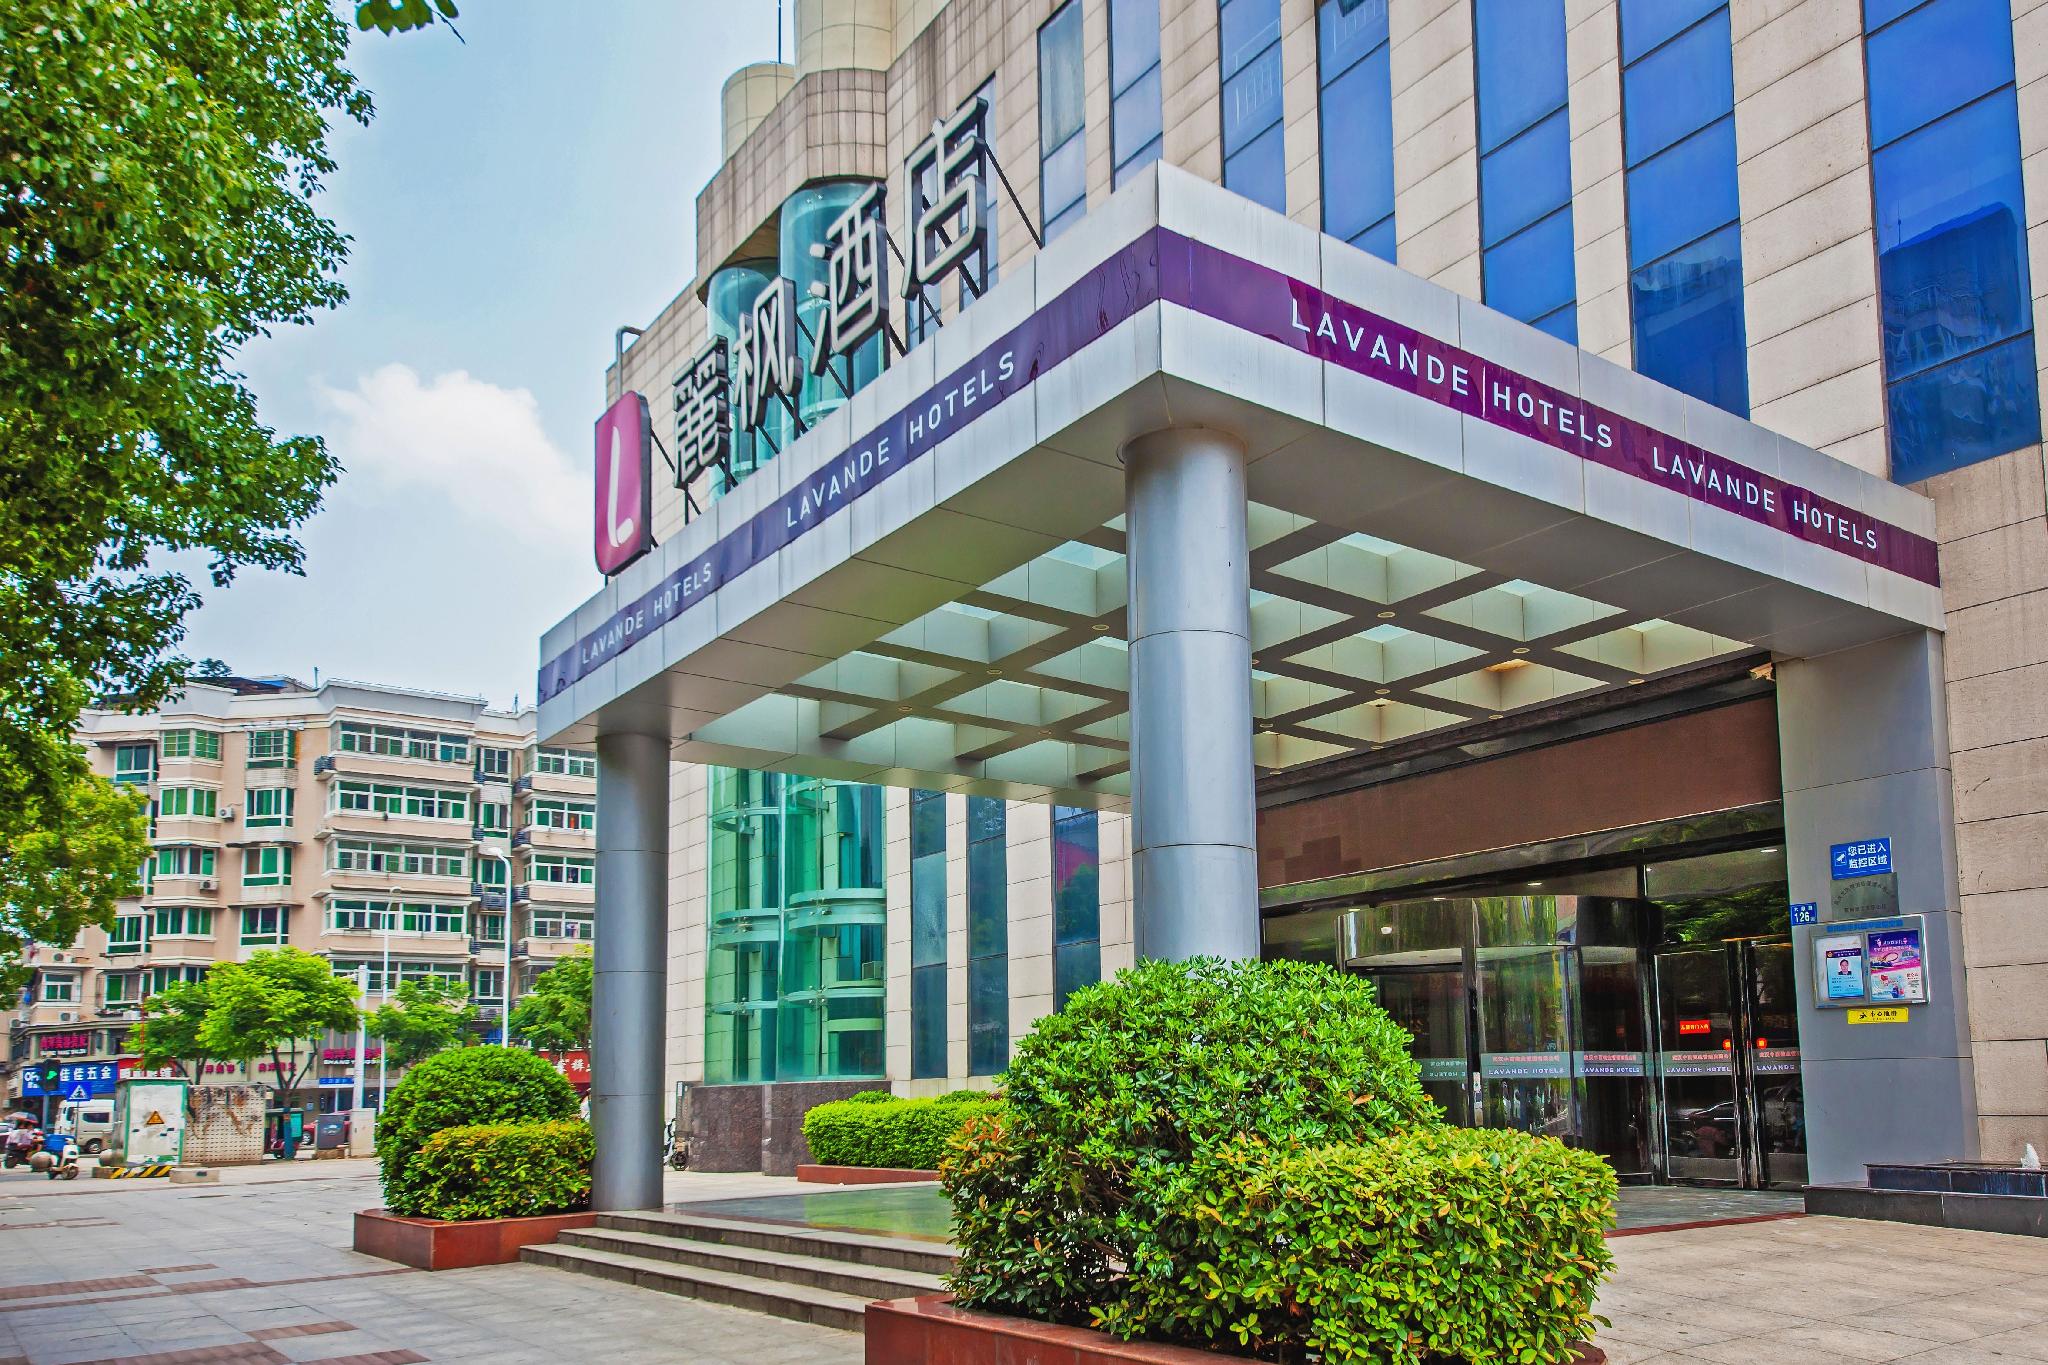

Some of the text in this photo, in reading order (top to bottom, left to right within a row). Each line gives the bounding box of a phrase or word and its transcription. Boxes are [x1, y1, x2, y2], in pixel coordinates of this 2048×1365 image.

[1291, 298, 1613, 448] LAVANDE HOTELS
[787, 351, 1014, 528] LAVANDE HOTELS
[1653, 446, 1877, 549] LAVANDE HOTELS
[582, 562, 712, 664] LAVANDE HOTELS
[1848, 843, 1887, 856] 您已进入
[1849, 855, 1888, 868] 监控区域
